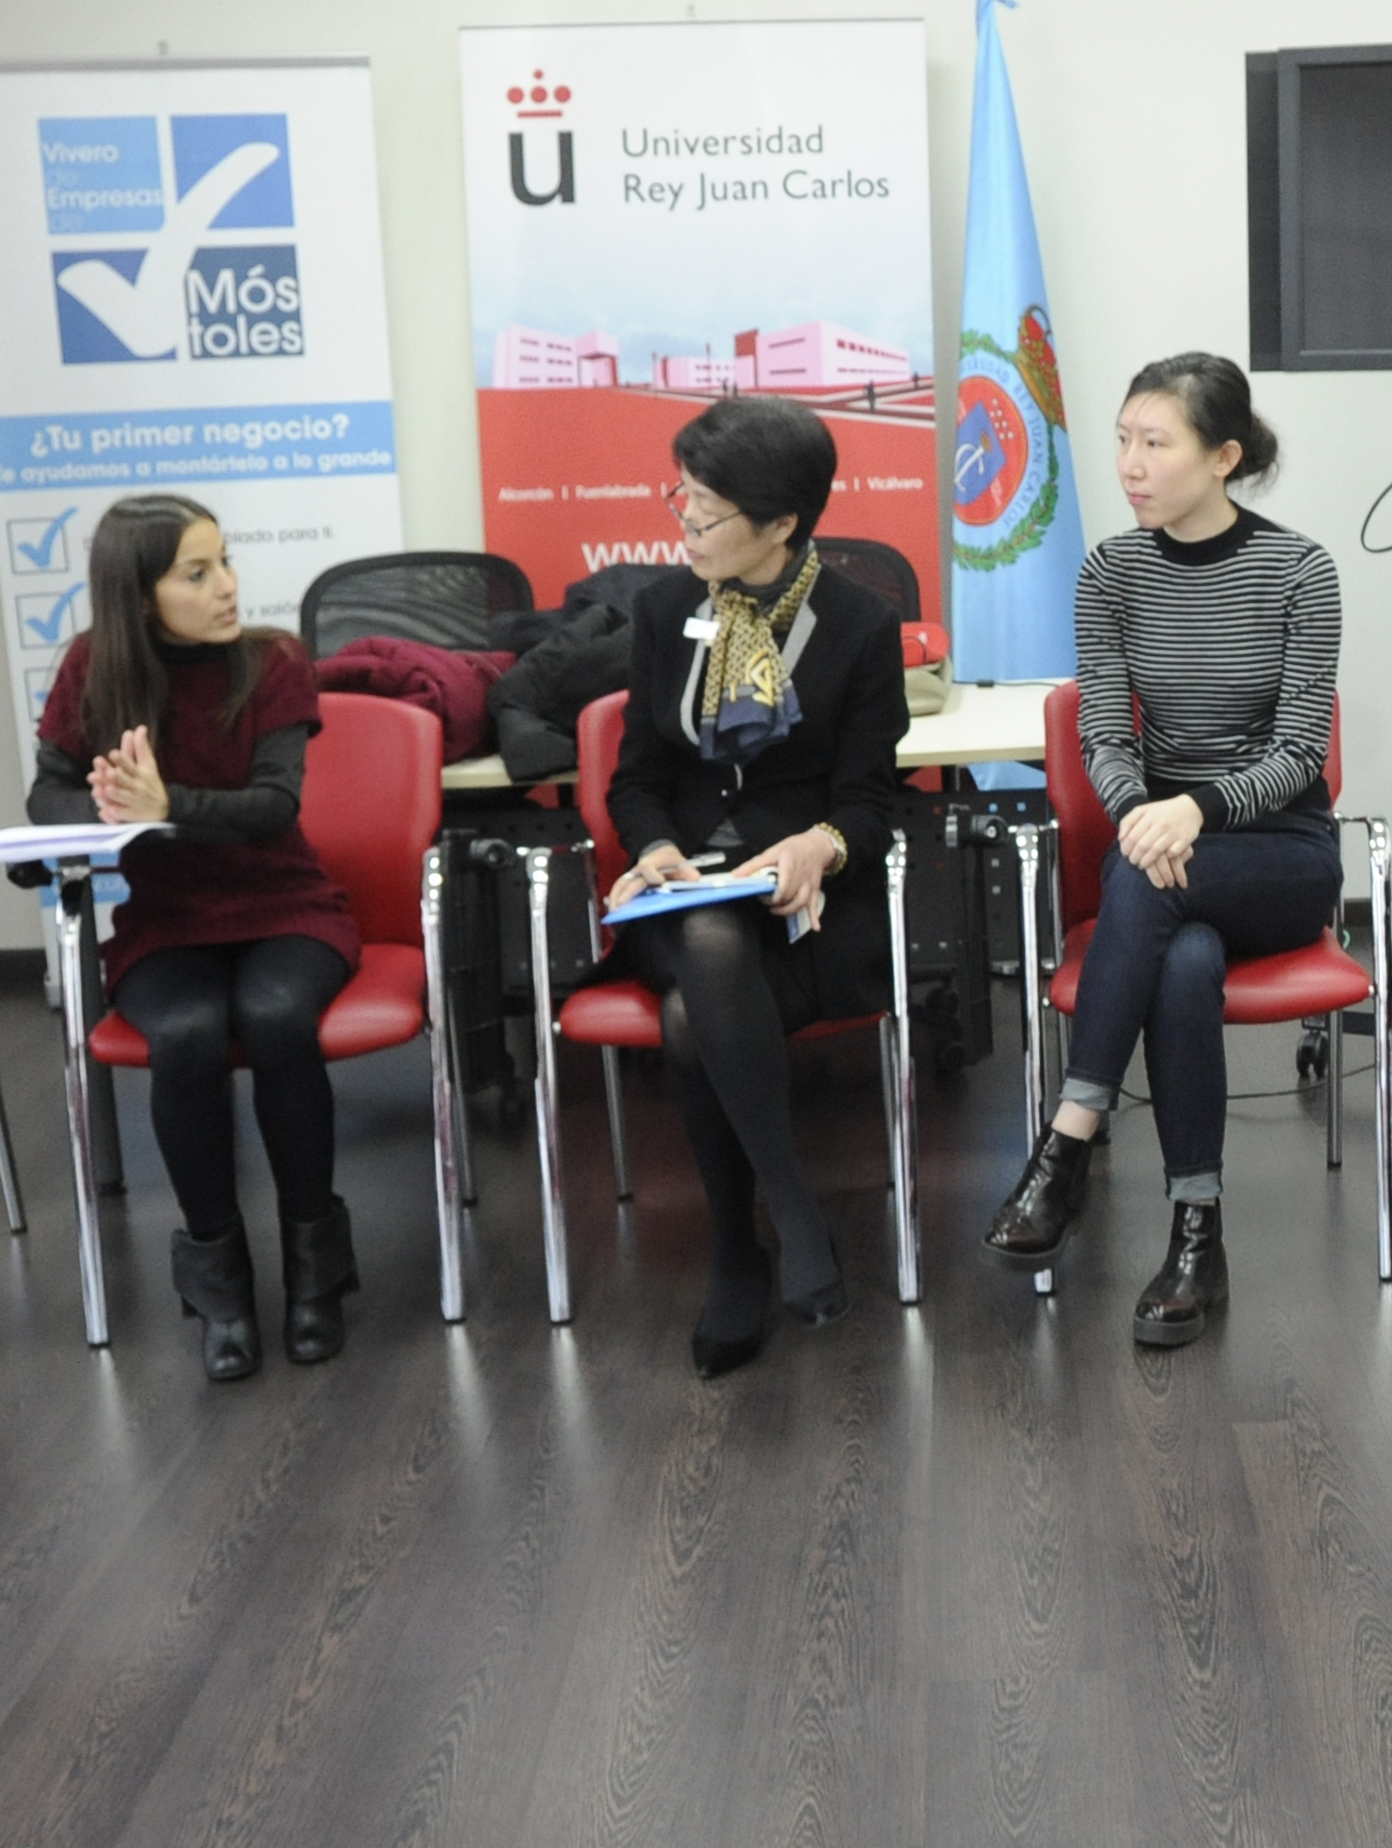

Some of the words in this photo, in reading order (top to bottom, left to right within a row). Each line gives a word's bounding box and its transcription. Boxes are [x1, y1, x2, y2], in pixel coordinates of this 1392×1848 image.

[41, 142, 119, 163] Vivero
[621, 124, 824, 157] Universidad
[47, 187, 163, 213] Empresas
[623, 173, 684, 211] Rey
[697, 172, 769, 211] Juan
[783, 169, 890, 200] Carlos
[187, 263, 300, 314] Mós
[189, 313, 302, 356] toles
[30, 424, 82, 458] ¿Tu
[91, 421, 194, 454] primer
[203, 412, 350, 449] negocio?
[20, 463, 131, 485] ayudamos
[136, 461, 150, 476] a
[273, 455, 288, 470] a
[317, 449, 392, 473] grande
[581, 541, 689, 573] www
